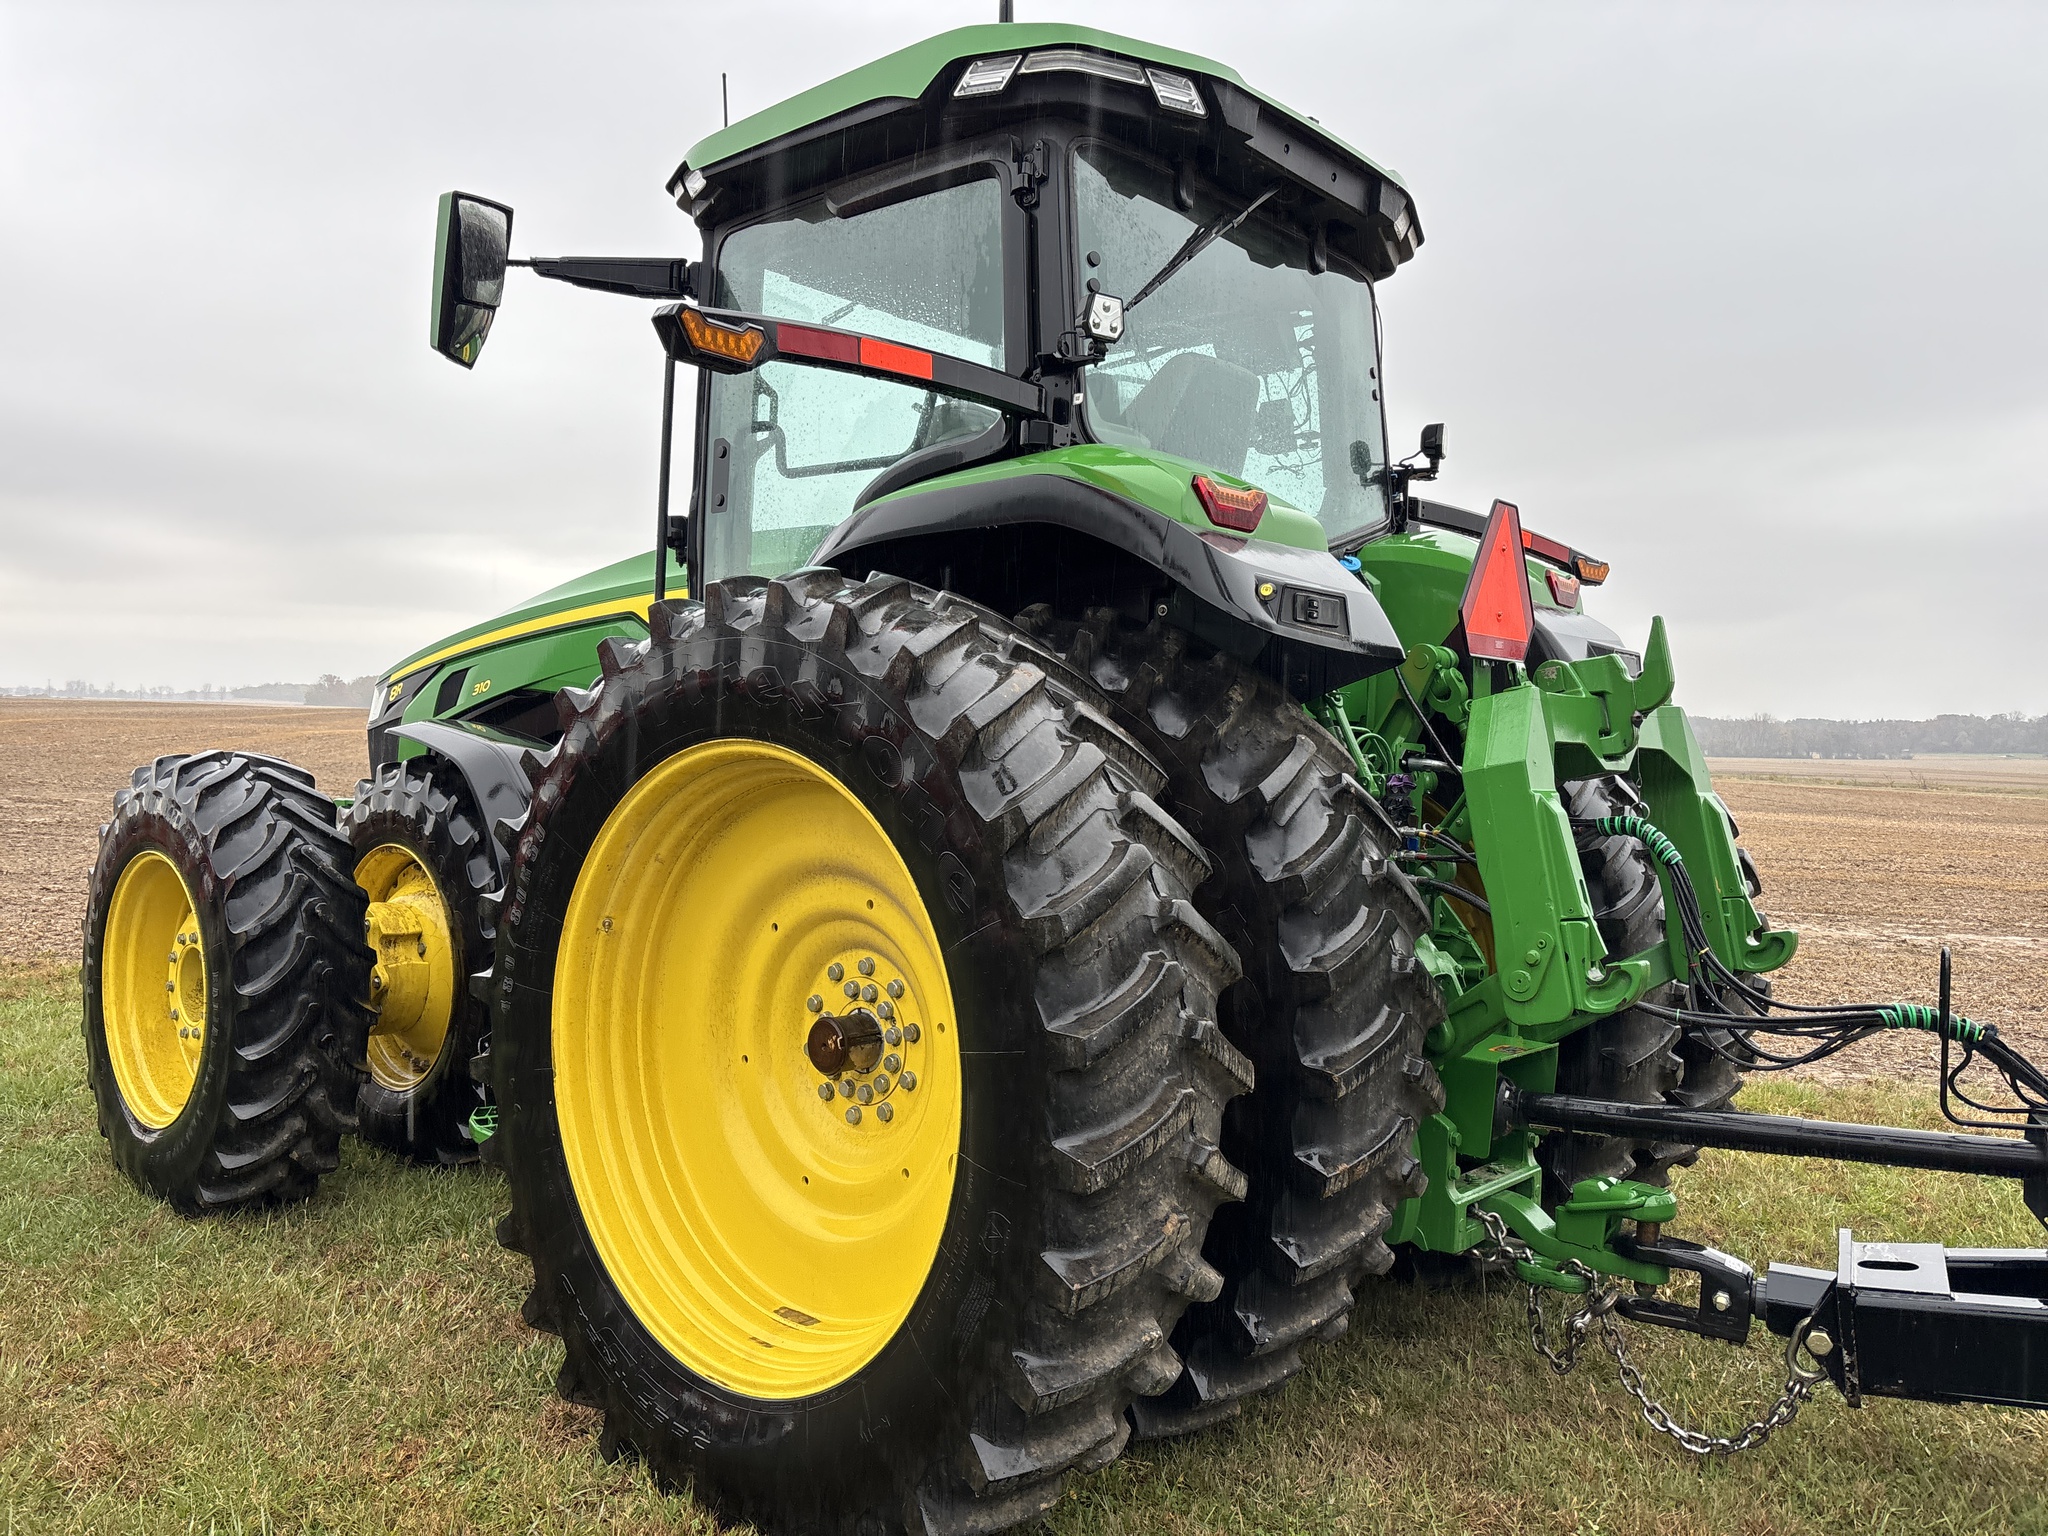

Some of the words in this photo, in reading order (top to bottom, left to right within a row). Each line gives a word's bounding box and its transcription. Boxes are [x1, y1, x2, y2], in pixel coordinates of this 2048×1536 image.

[389, 682, 404, 702] 8R
[471, 679, 491, 696] 310
[645, 660, 977, 916] Firestone
